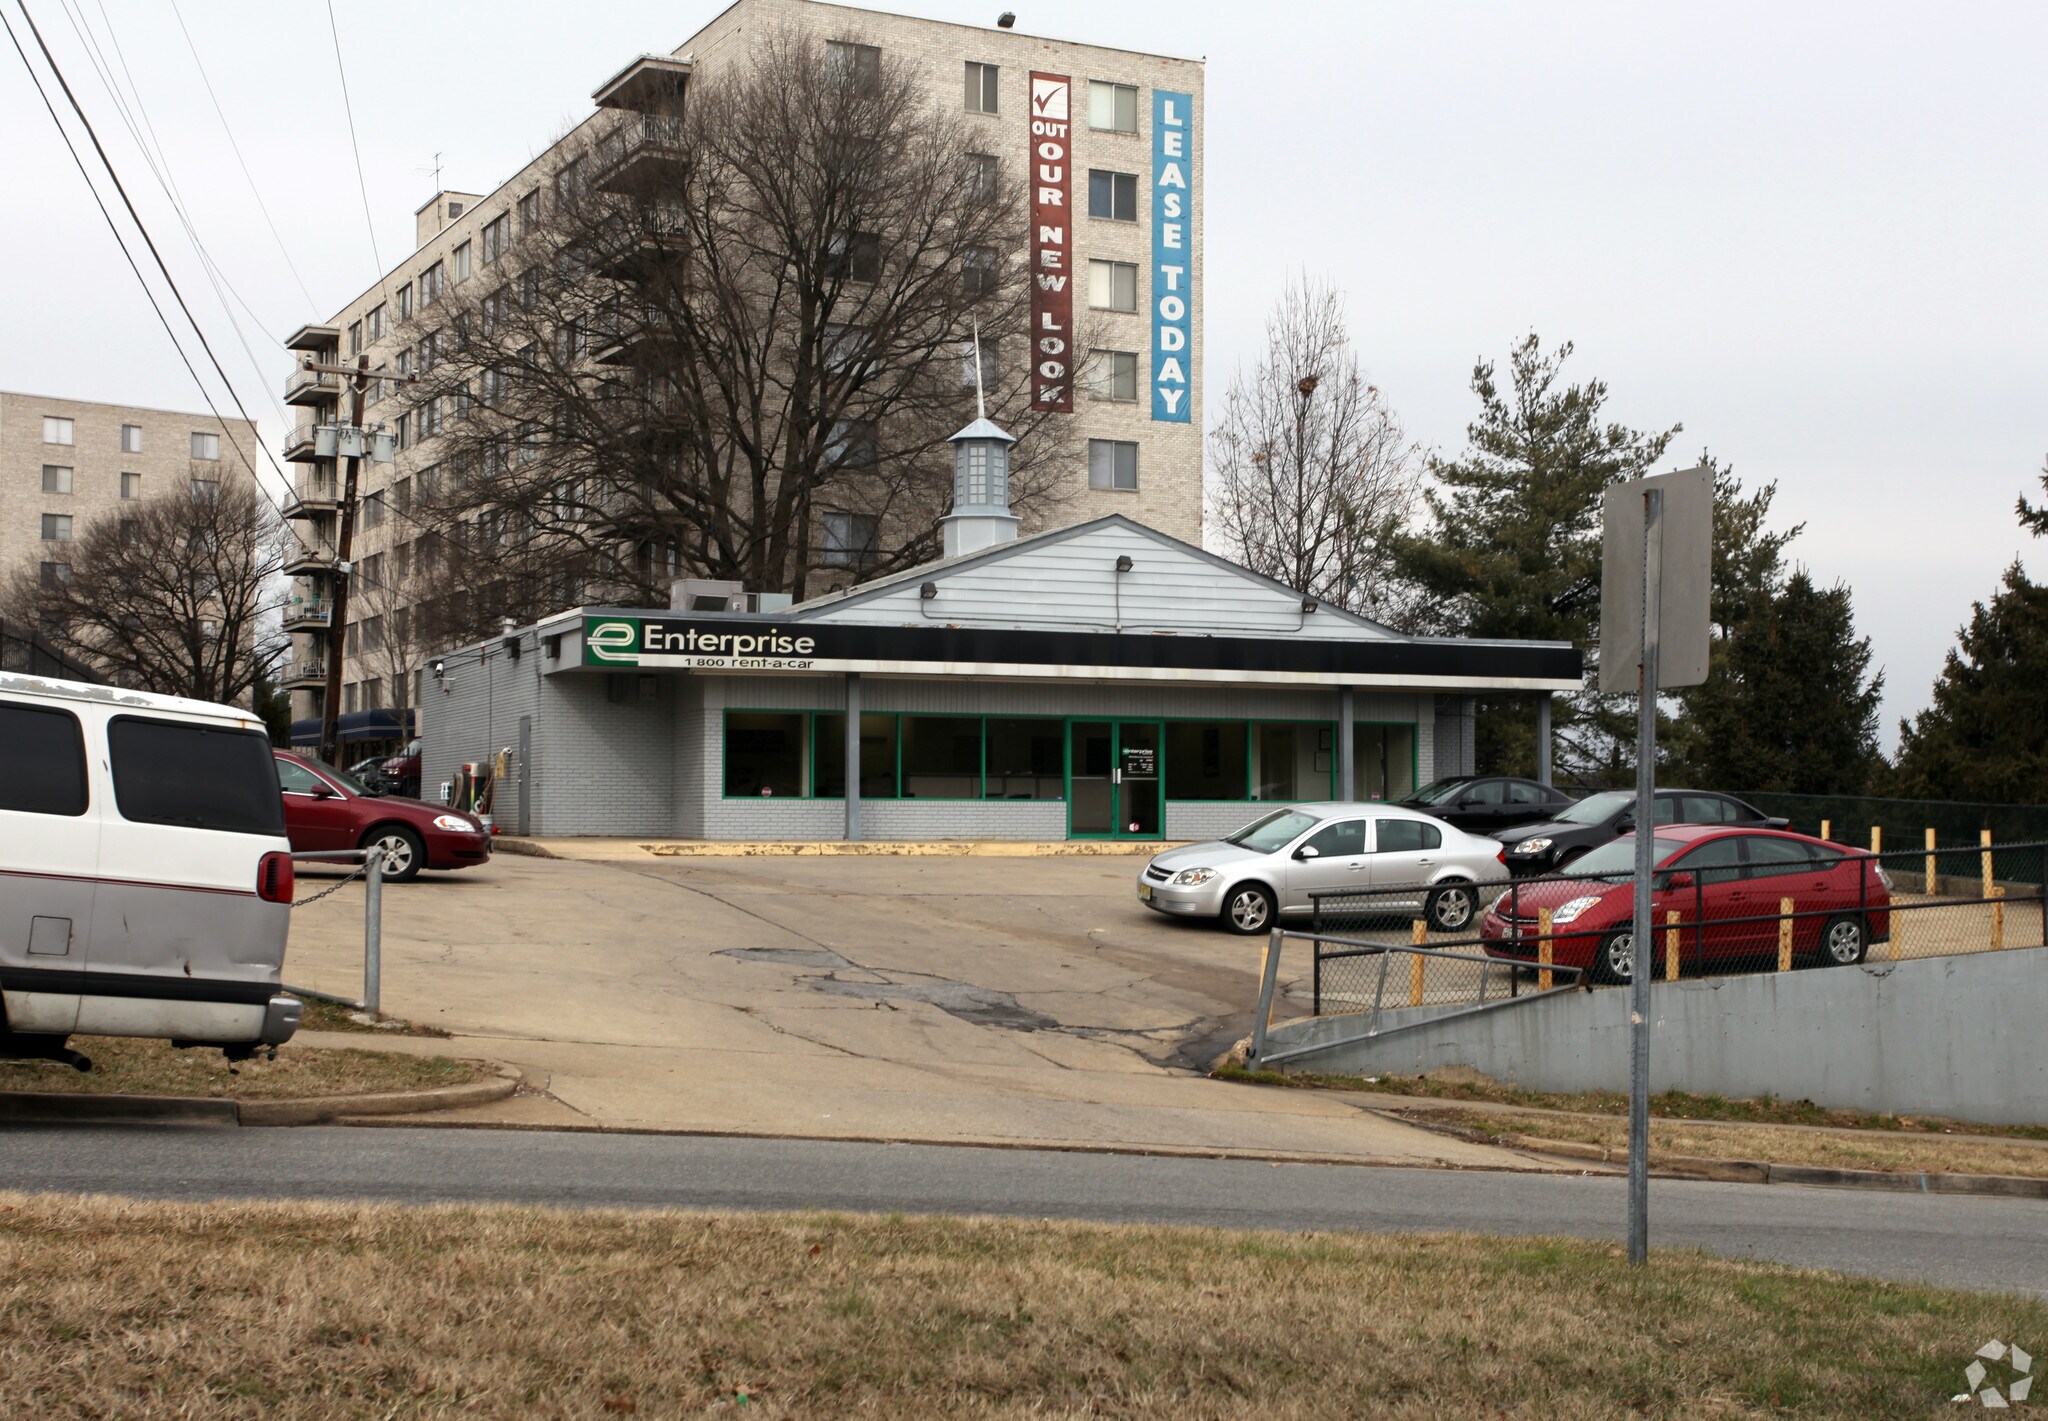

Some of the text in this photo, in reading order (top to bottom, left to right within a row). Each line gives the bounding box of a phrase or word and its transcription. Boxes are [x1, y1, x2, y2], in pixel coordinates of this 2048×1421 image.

[1032, 122, 1068, 138] OUT
[1036, 143, 1067, 404] OUR NEW LOOK
[1158, 100, 1186, 414] LEASE TODAY
[644, 624, 815, 658] Enterprise
[731, 658, 814, 669] rent-a-car
